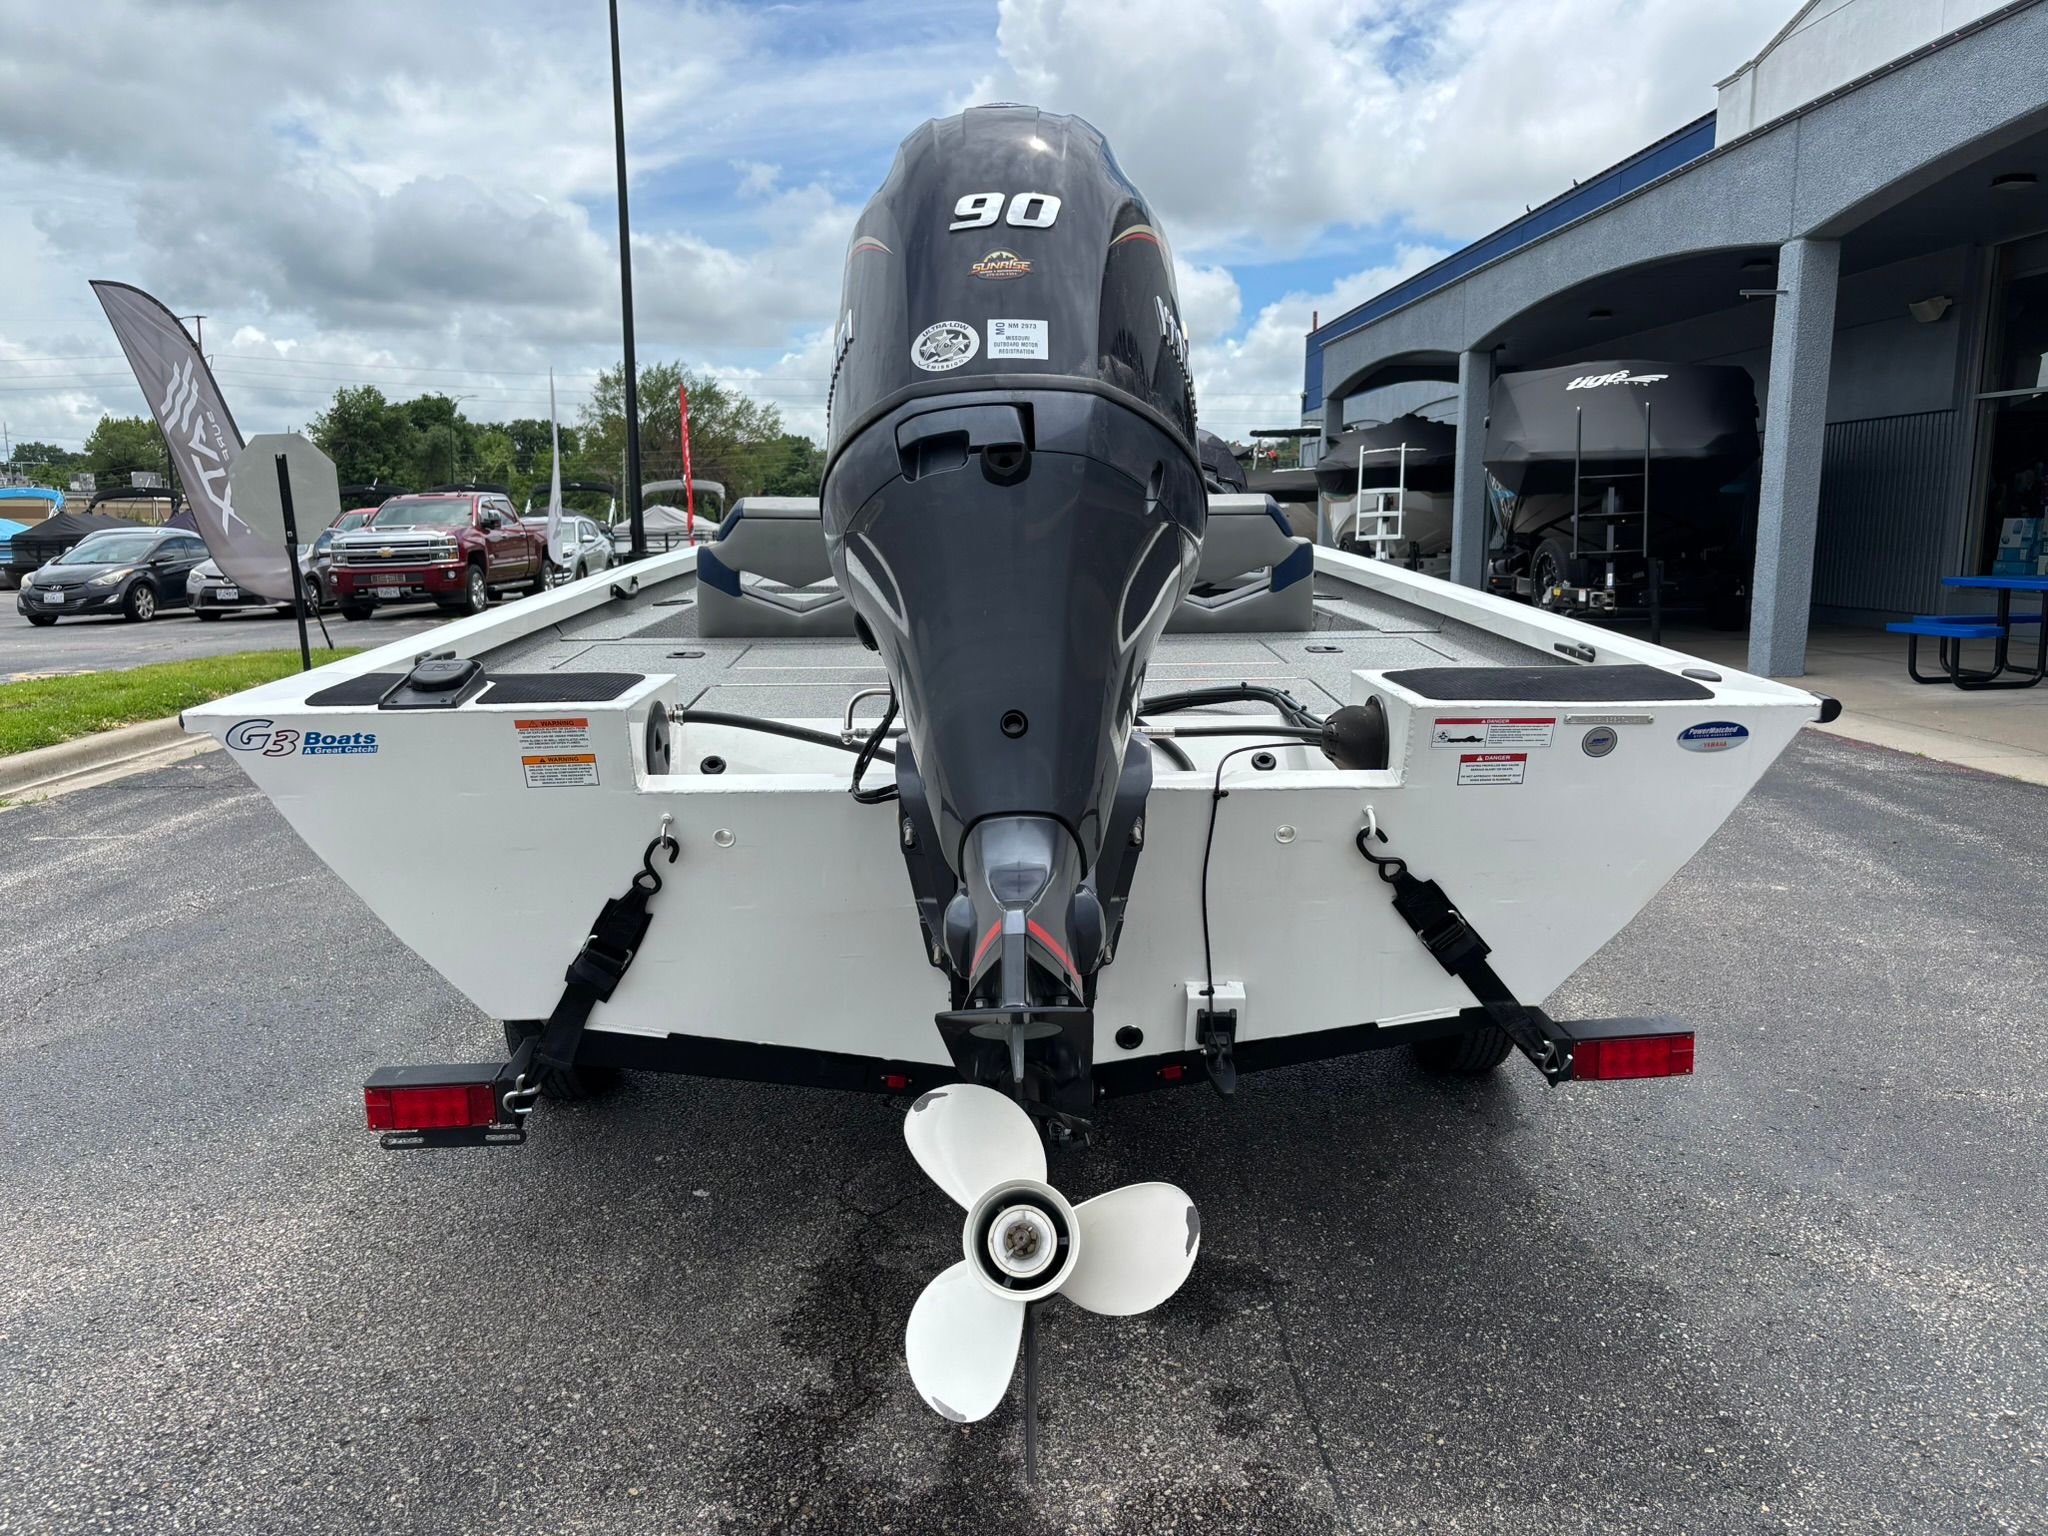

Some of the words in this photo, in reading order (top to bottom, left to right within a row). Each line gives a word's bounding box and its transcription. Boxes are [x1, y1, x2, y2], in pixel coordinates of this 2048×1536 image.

[949, 192, 1061, 231] 90
[971, 260, 1031, 273] SUNRISE
[922, 322, 969, 337] ULTRA-LOW
[995, 322, 1005, 335] MO
[225, 718, 301, 757] G3
[303, 731, 377, 746] Boats
[304, 747, 313, 755] A
[315, 747, 342, 755] Great
[346, 745, 378, 754] Catch!
